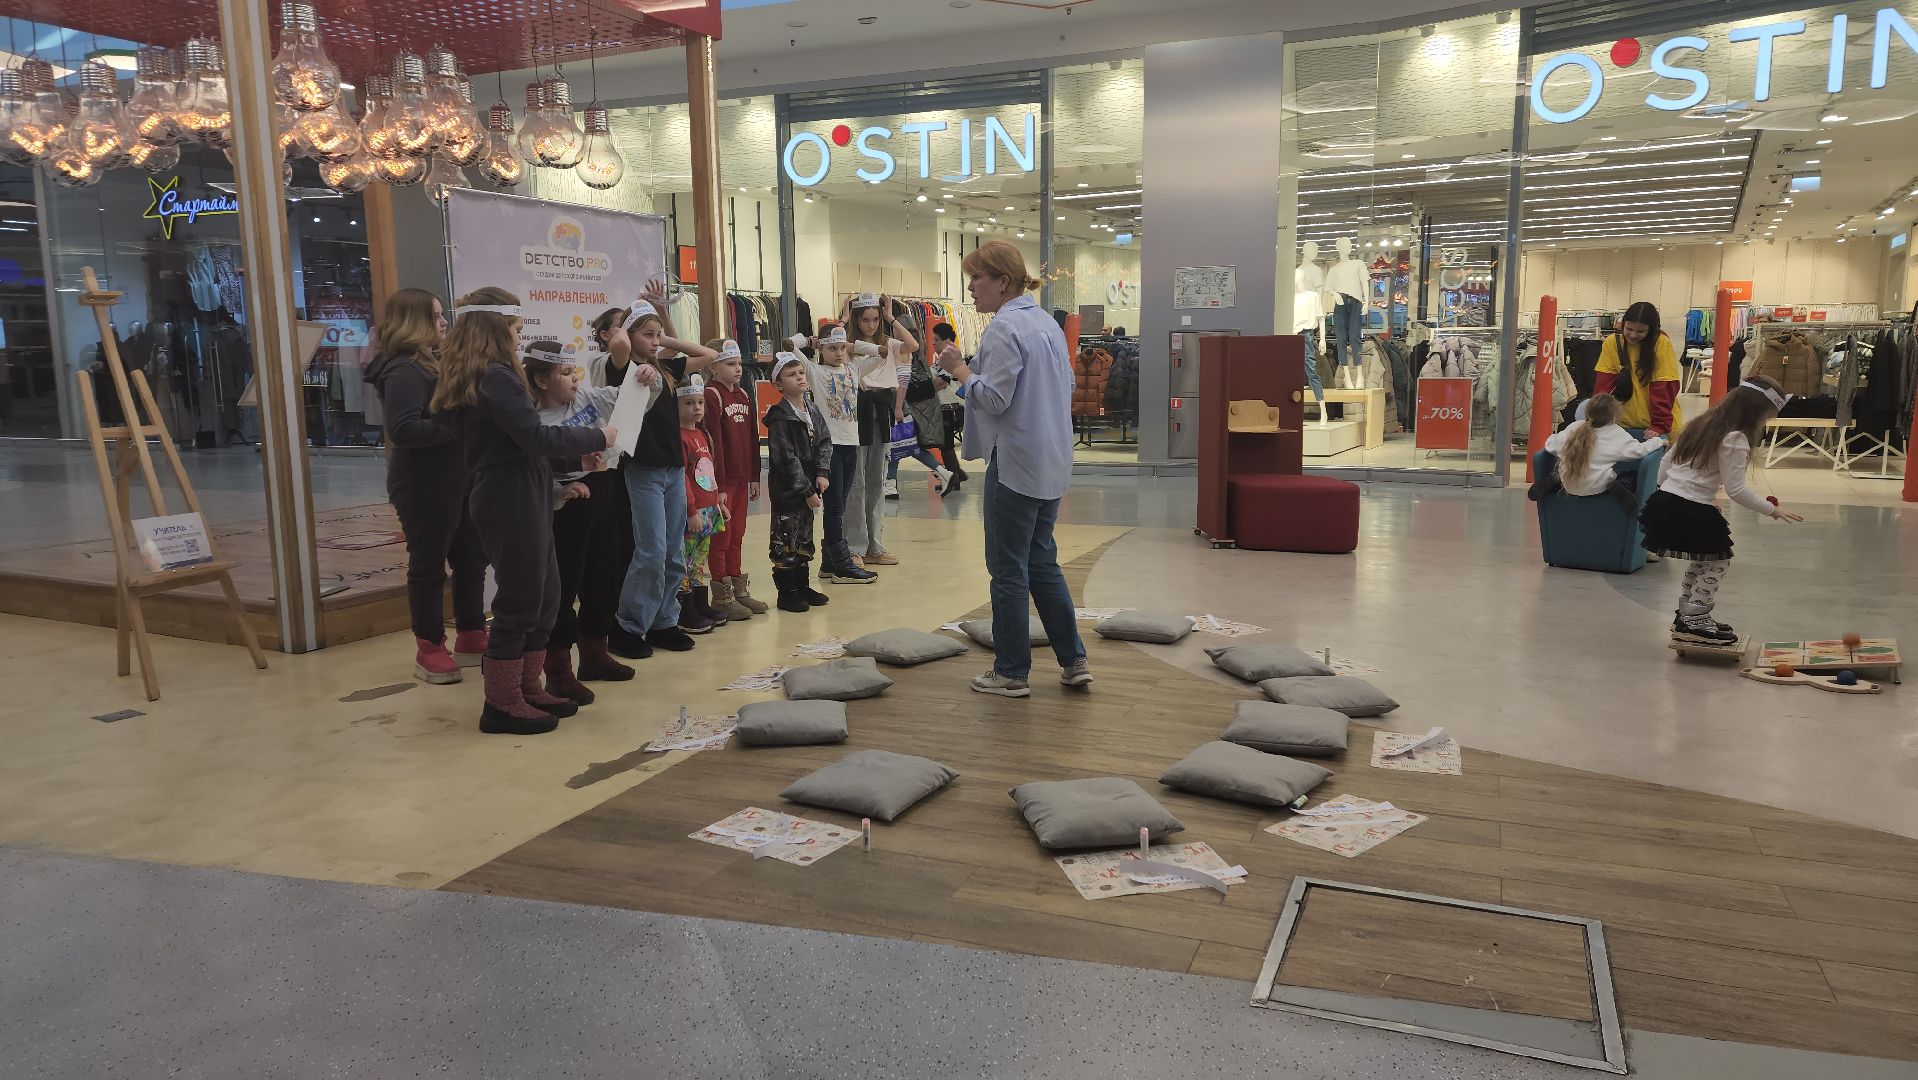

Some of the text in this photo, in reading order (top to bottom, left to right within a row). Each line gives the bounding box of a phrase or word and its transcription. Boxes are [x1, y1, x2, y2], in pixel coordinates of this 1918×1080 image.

[529, 289, 608, 305] НАПРАВЛЕНИЯ:
[523, 318, 541, 326] ОПЕД
[724, 402, 749, 416] BOSTON
